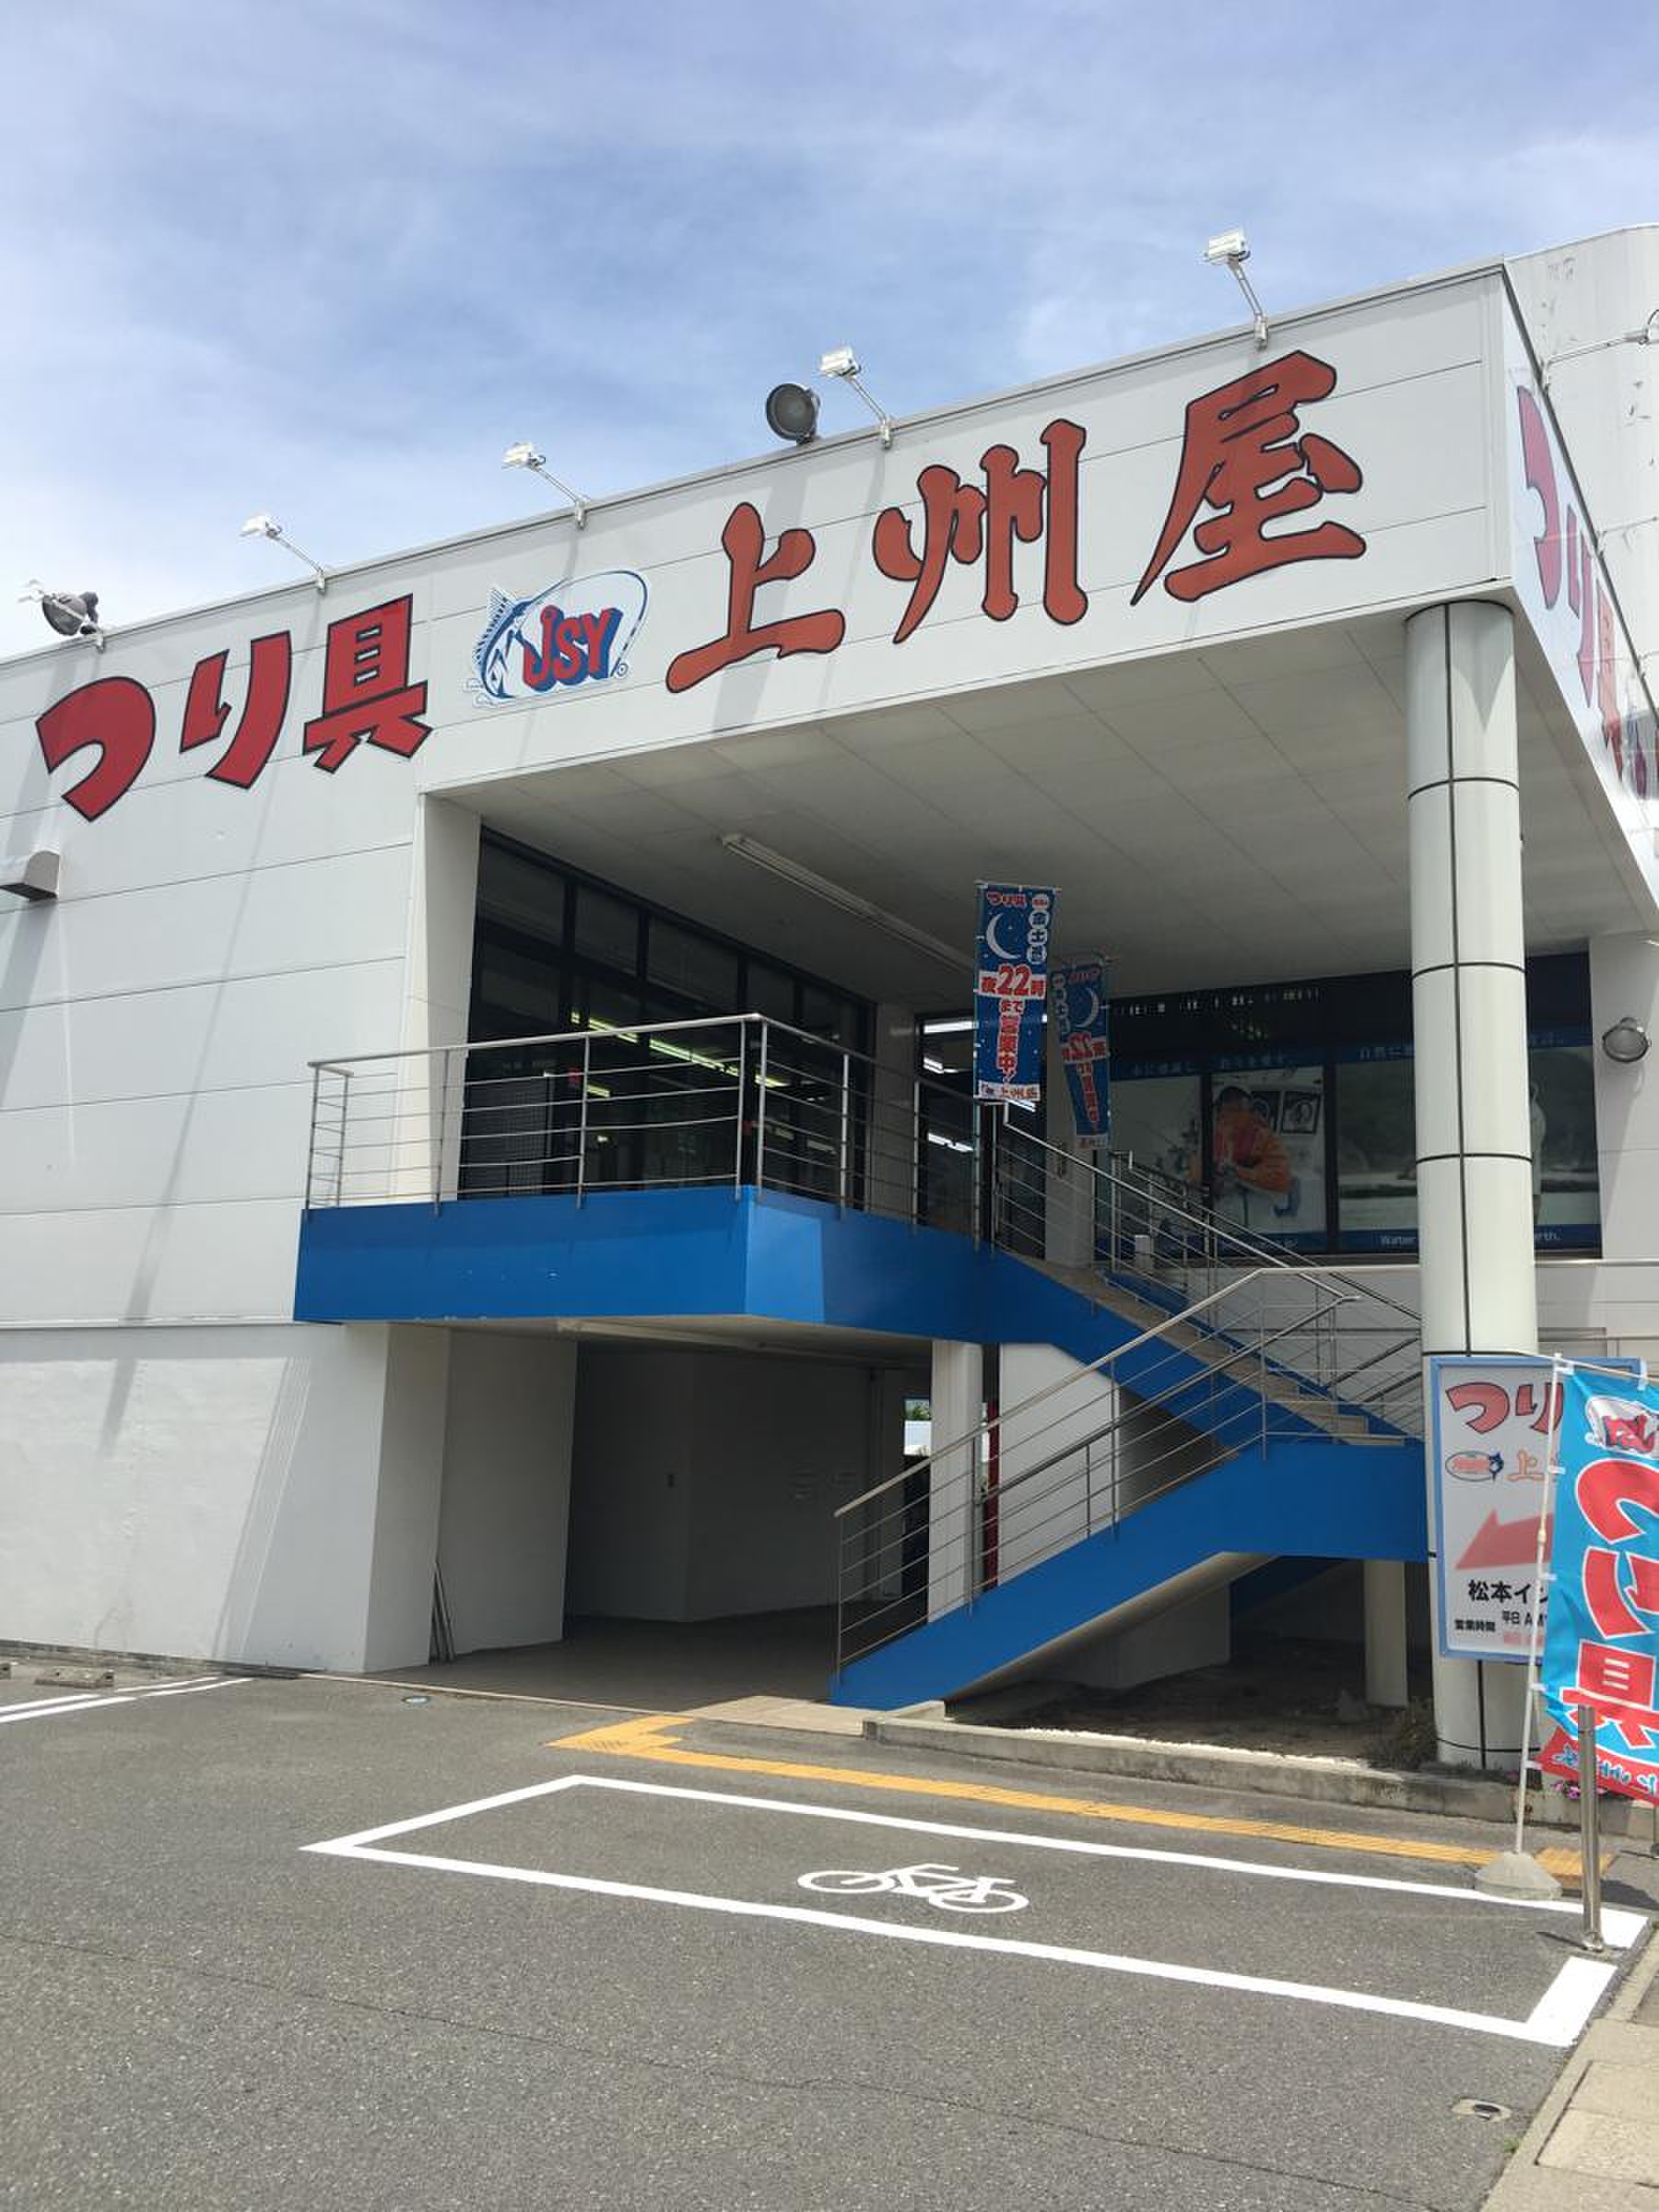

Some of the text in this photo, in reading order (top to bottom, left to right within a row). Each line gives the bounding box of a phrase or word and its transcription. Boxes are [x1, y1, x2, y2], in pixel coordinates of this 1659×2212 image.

[36, 349, 1367, 822] つり具 JSY 上州屋
[1454, 1619, 1496, 1632] 営業時間
